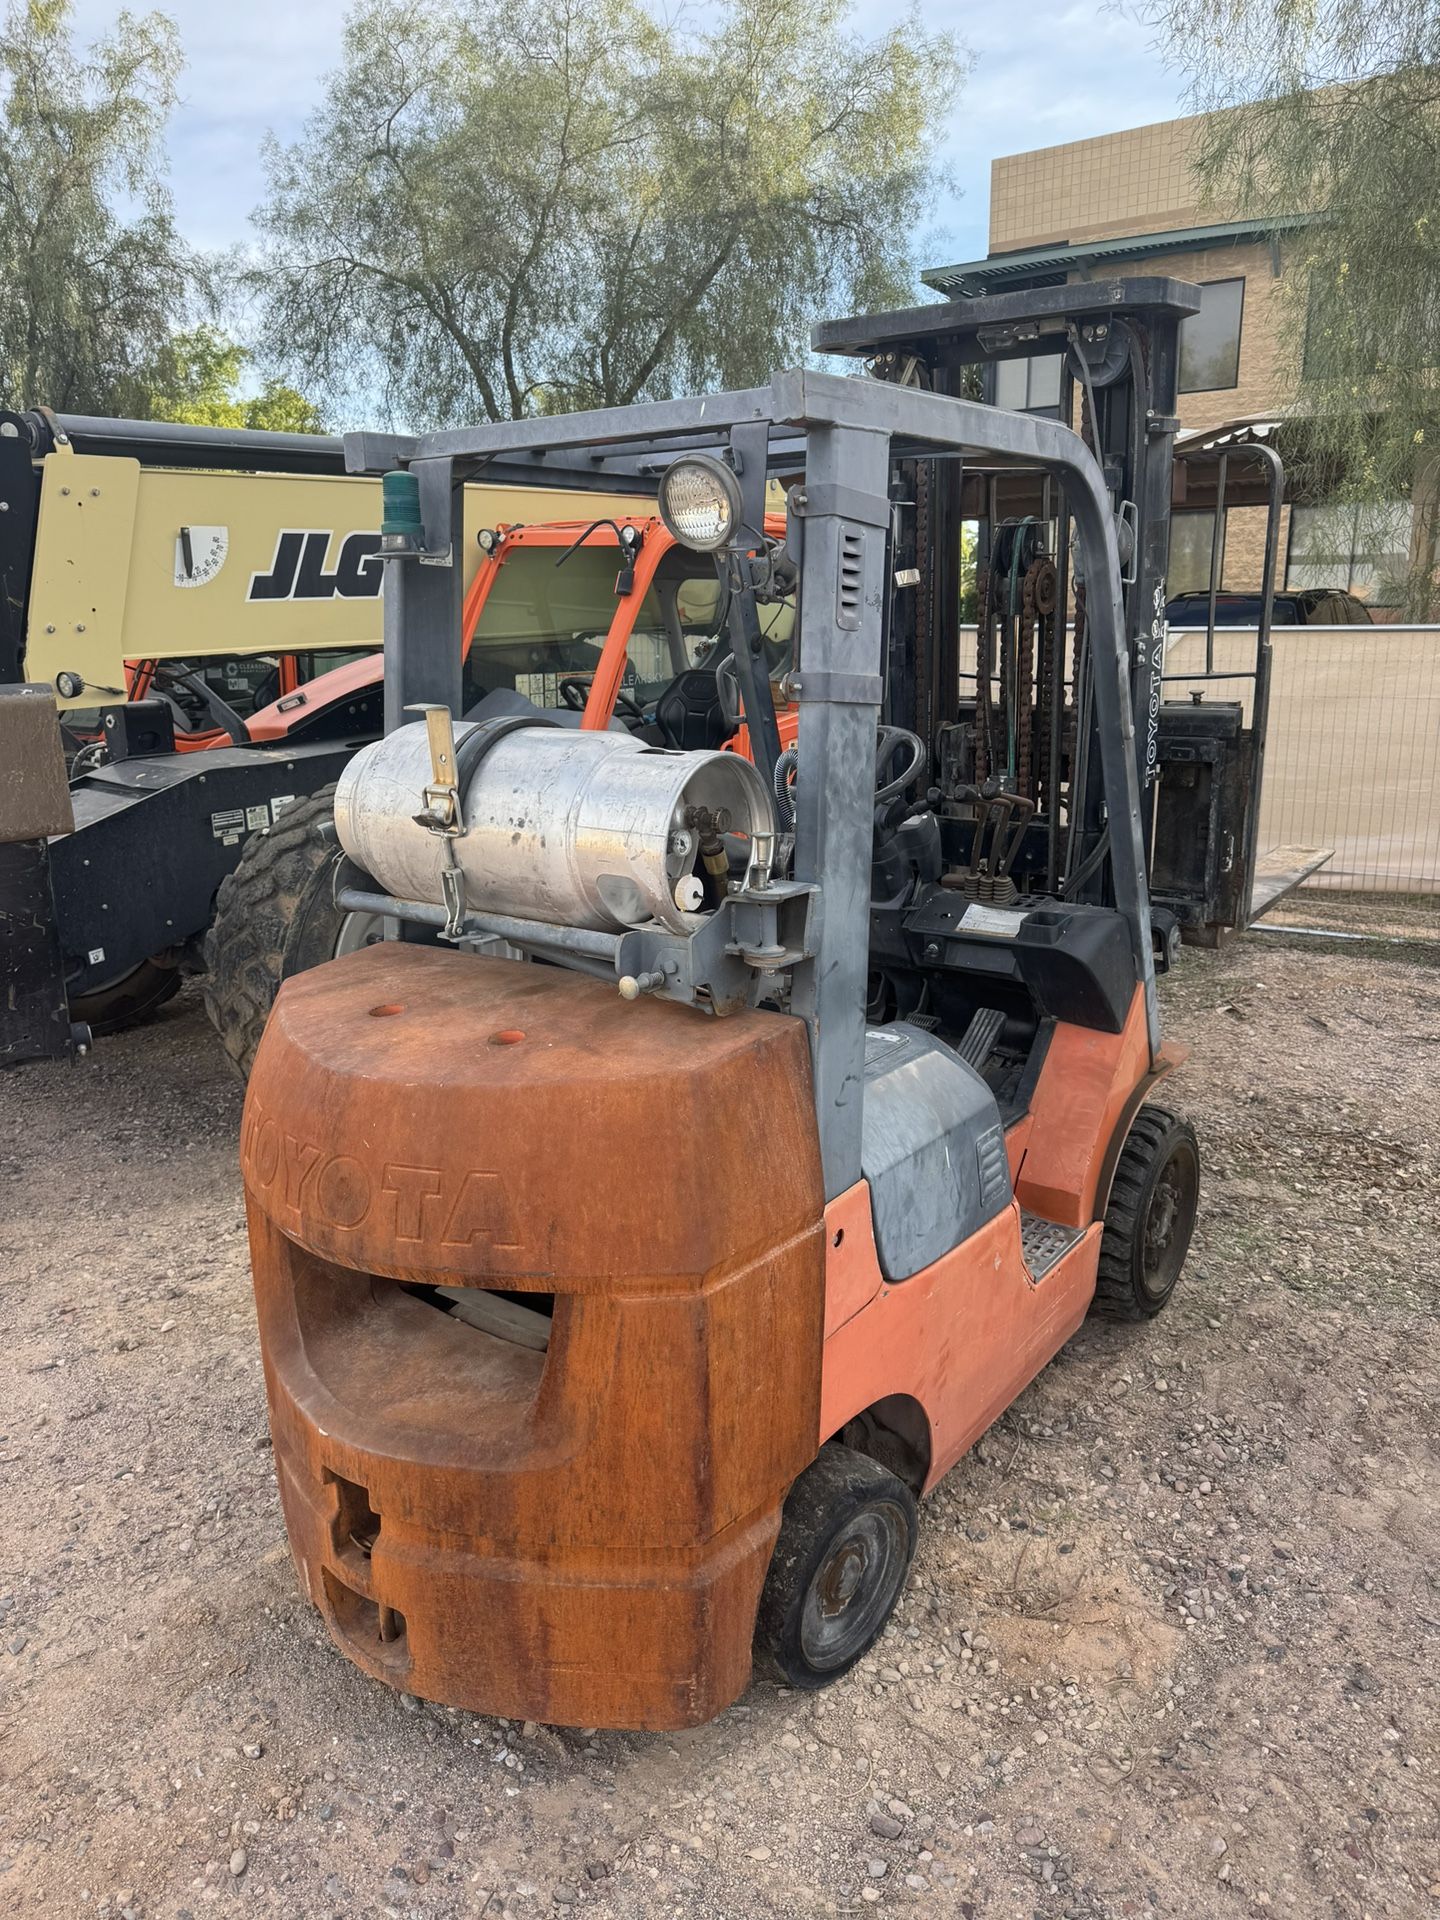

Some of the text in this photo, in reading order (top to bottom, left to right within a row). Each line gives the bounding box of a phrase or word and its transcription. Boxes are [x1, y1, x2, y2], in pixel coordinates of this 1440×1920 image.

[246, 528, 384, 602] JLG
[1144, 643, 1163, 788] TOYOTA
[244, 1092, 526, 1250] TOYOTA
